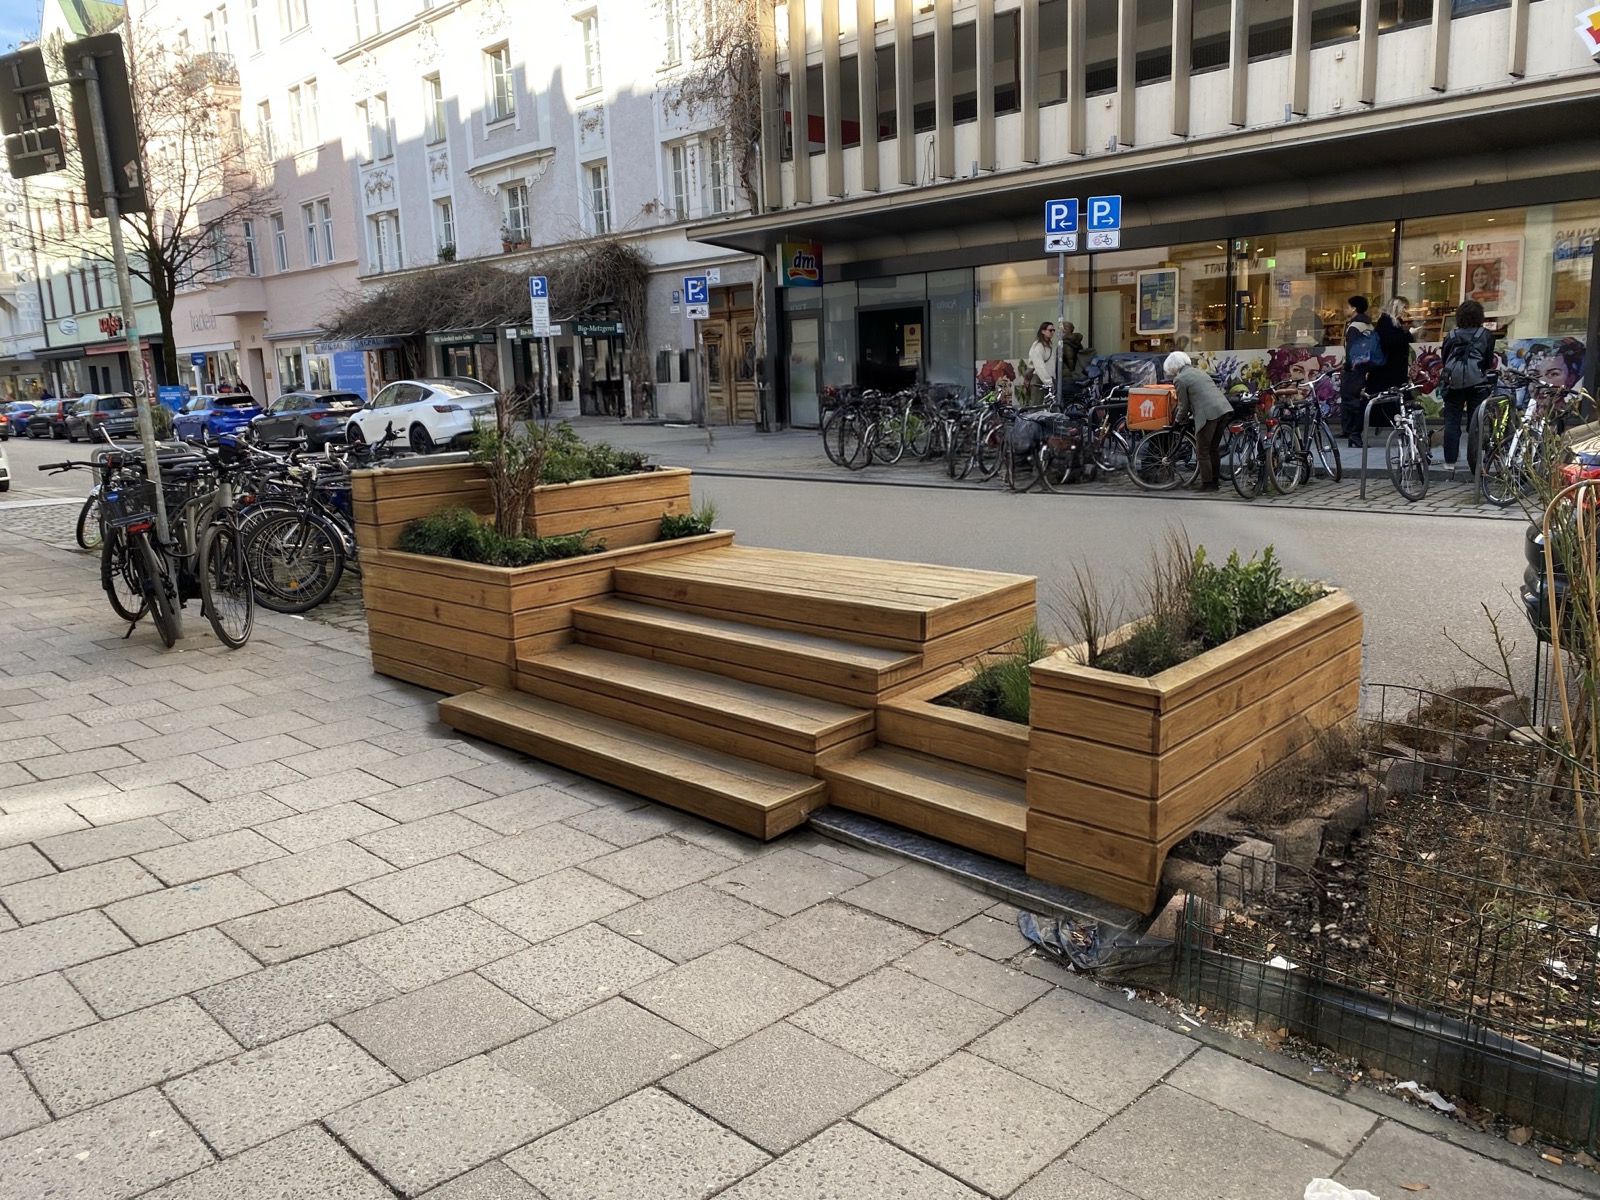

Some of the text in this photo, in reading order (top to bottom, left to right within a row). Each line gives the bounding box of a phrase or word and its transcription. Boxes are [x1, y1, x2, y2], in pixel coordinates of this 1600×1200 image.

[1051, 204, 1069, 229] P
[1093, 201, 1111, 226] P
[793, 250, 815, 269] dm
[532, 279, 542, 295] P
[688, 280, 701, 300] P
[577, 324, 615, 333] Bio-Metzgerei
